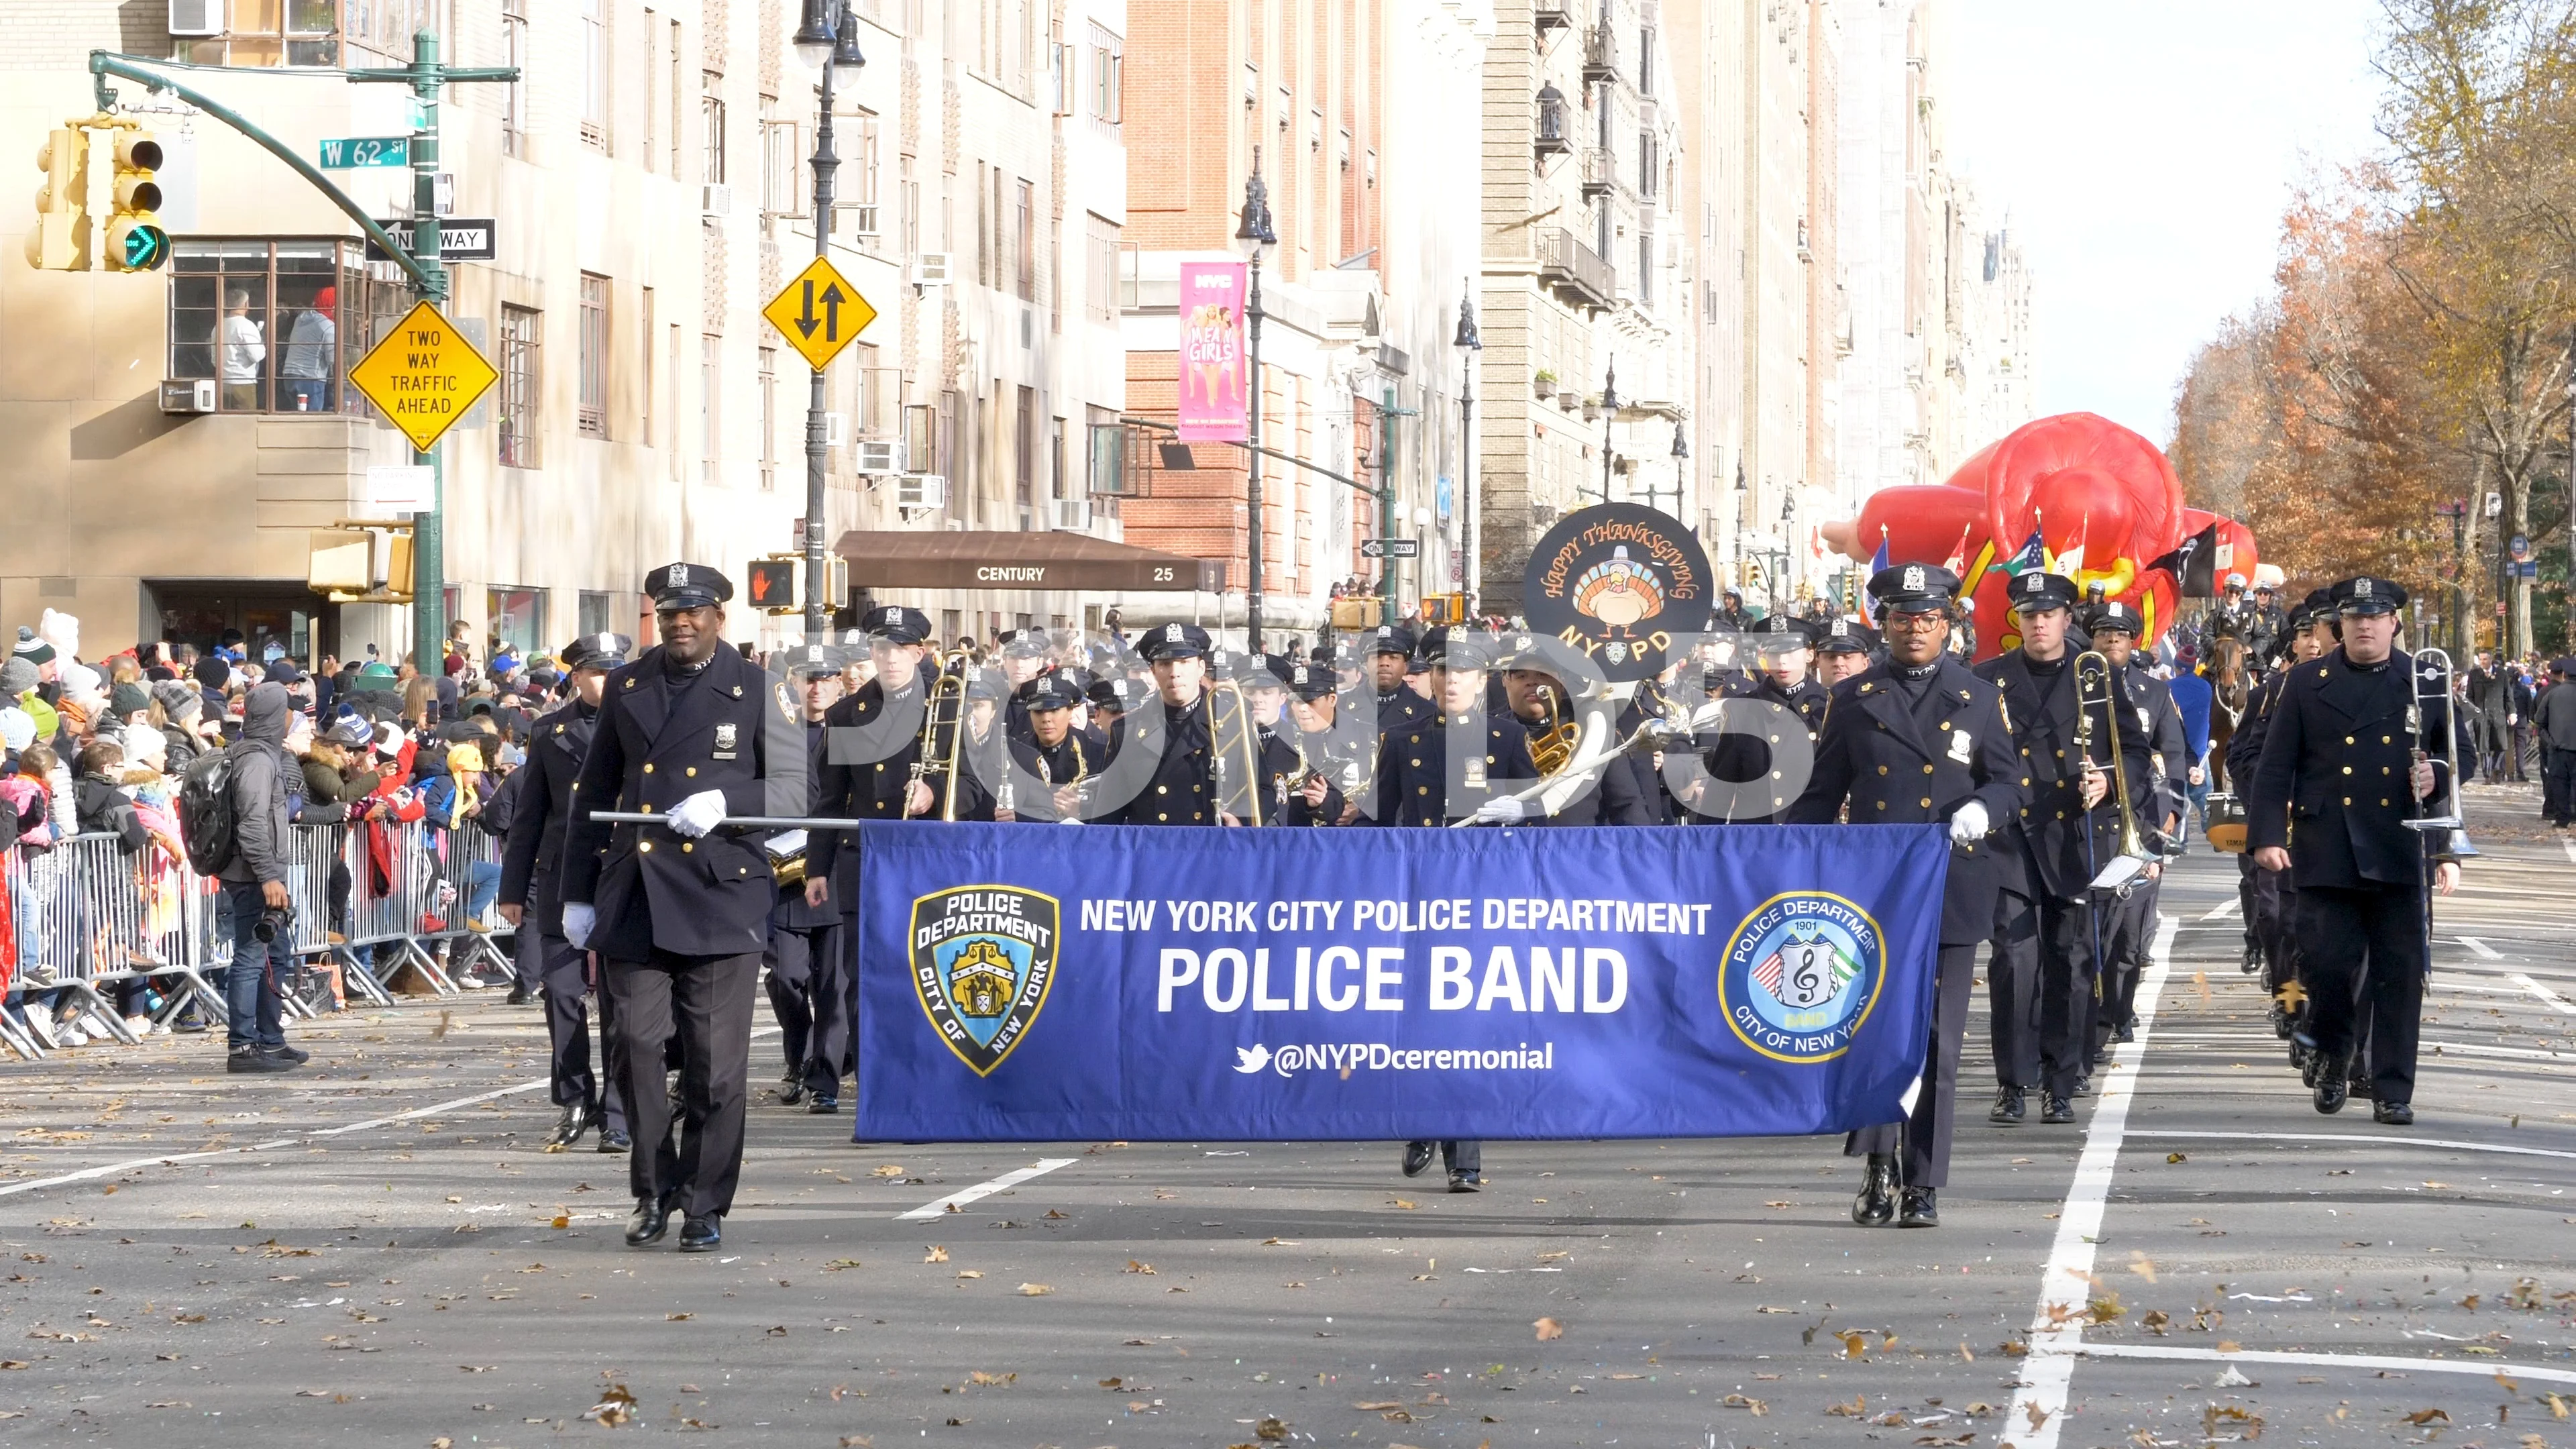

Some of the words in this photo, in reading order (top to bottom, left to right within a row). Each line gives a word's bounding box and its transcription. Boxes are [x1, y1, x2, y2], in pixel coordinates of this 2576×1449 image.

[325, 142, 343, 166] W
[353, 140, 382, 166] 62
[391, 140, 405, 154] ST
[440, 231, 478, 248] WAY
[1195, 274, 1232, 288] NYC
[407, 331, 441, 346] TWO
[1191, 326, 1232, 343] MEAN
[407, 354, 439, 369] WAY
[1189, 343, 1234, 362] GIRLS
[390, 376, 457, 391] TRAFFIC
[396, 398, 451, 414] AHEAD
[1395, 543, 1413, 553] WAY
[1540, 537, 1582, 598] HAPPY
[1583, 519, 1700, 600] THANKSGIVING
[976, 566, 1045, 582] CENTURY
[1153, 567, 1175, 582] 25
[1785, 682, 1806, 695] NYPD
[946, 892, 1024, 916] POLICE
[1081, 900, 1157, 932] NEW
[1166, 900, 1258, 932] YORK
[1267, 900, 1343, 931] CITY
[1352, 898, 1472, 932] POLICE
[1483, 898, 1712, 936] DEPARTMENT
[1794, 921, 1817, 930] 1901
[917, 913, 1051, 950] DEPARTMENT
[1733, 908, 1782, 963] POLICE
[1157, 945, 1405, 1013] POLICE
[1429, 945, 1629, 1014] BAND
[919, 966, 947, 1012] CITY
[943, 1018, 967, 1042] OF
[990, 1015, 1022, 1055] NEW
[1019, 959, 1049, 1008] YORK
[1735, 1006, 1767, 1037] CITY
[1766, 1031, 1791, 1049] OF
[1794, 1032, 1835, 1053] NEW
[1275, 1042, 1553, 1078] @NYPDceremonial
